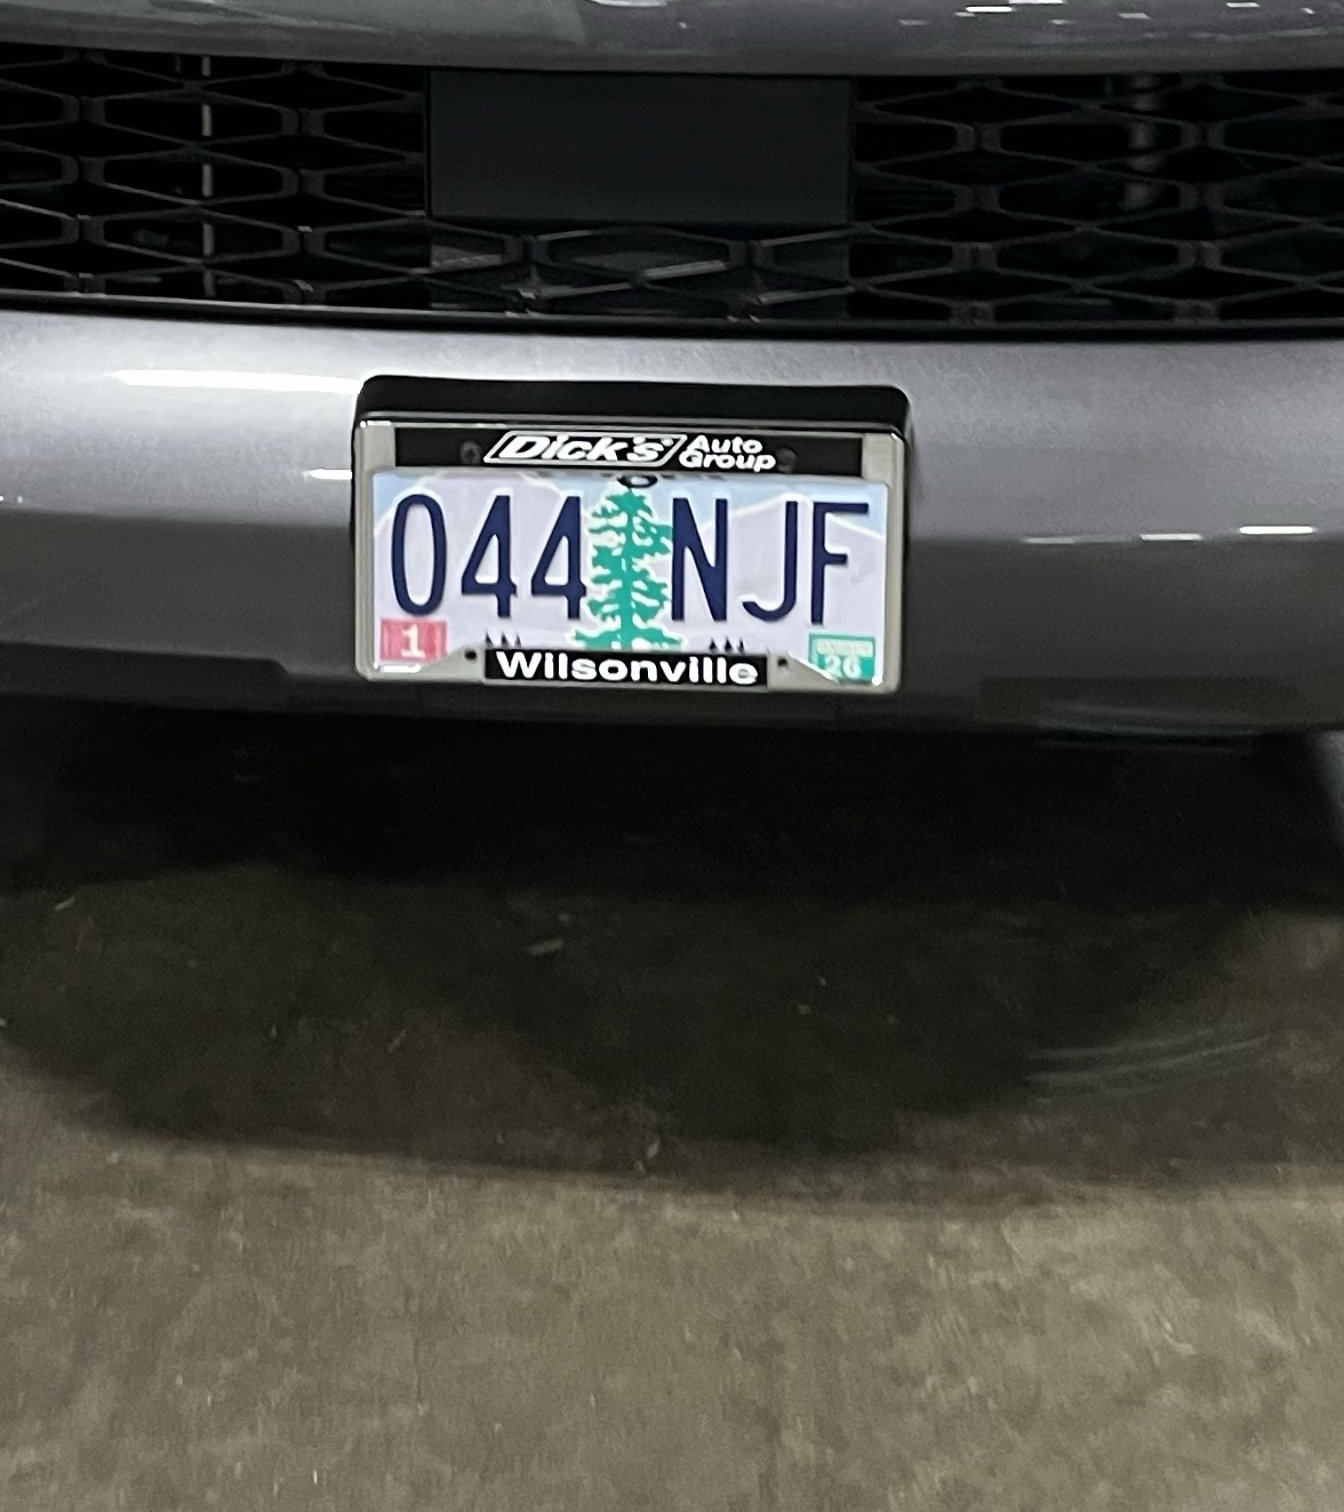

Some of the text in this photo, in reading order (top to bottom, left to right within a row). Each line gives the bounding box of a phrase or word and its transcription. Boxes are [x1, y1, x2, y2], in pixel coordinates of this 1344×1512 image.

[686, 434, 763, 454] Auto
[678, 450, 777, 472] Group
[401, 624, 426, 658] 1
[495, 651, 759, 685] Wilsonville
